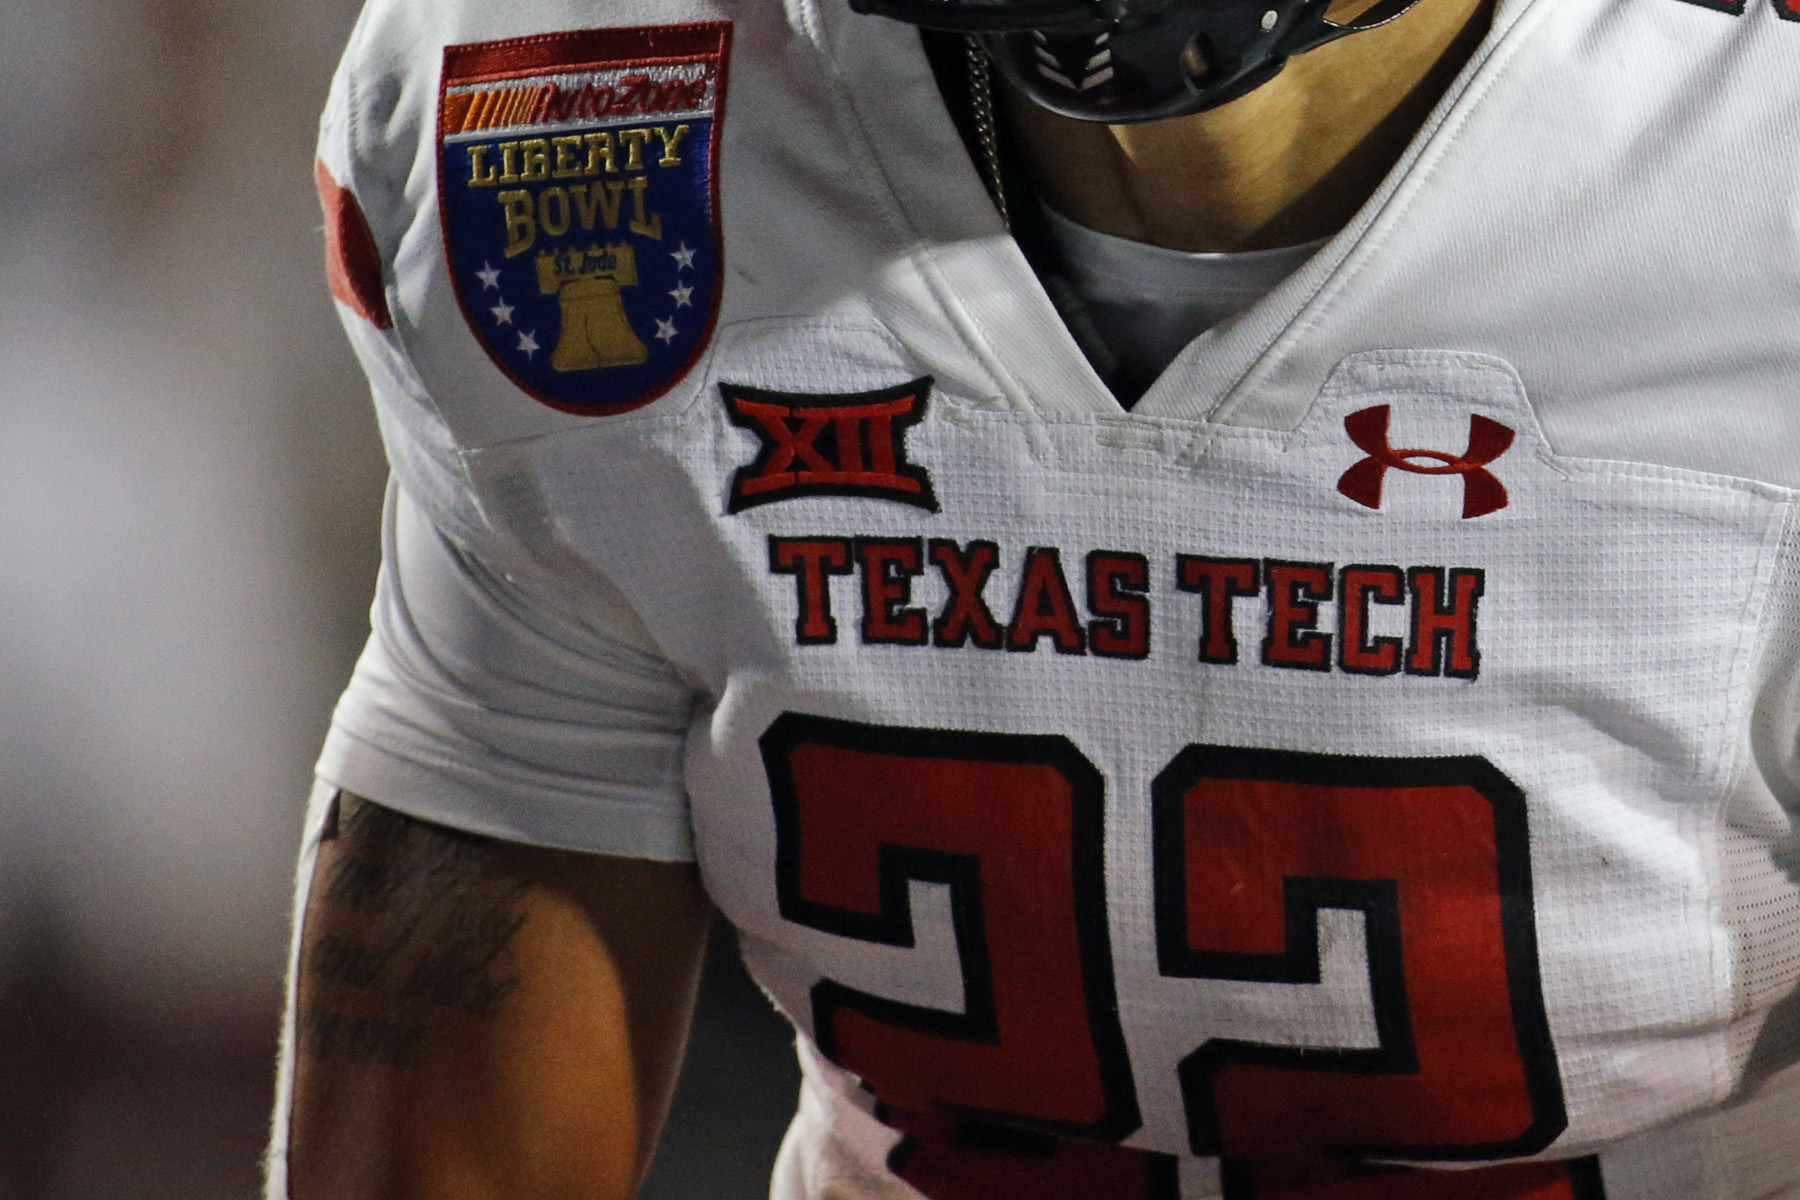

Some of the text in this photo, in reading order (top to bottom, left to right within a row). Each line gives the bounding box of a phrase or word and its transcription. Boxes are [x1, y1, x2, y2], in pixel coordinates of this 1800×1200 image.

[467, 124, 690, 188] LIBERTY
[497, 175, 663, 259] BOWL
[768, 535, 1486, 682] TEXAS TECH
[758, 710, 1570, 1172] 22
